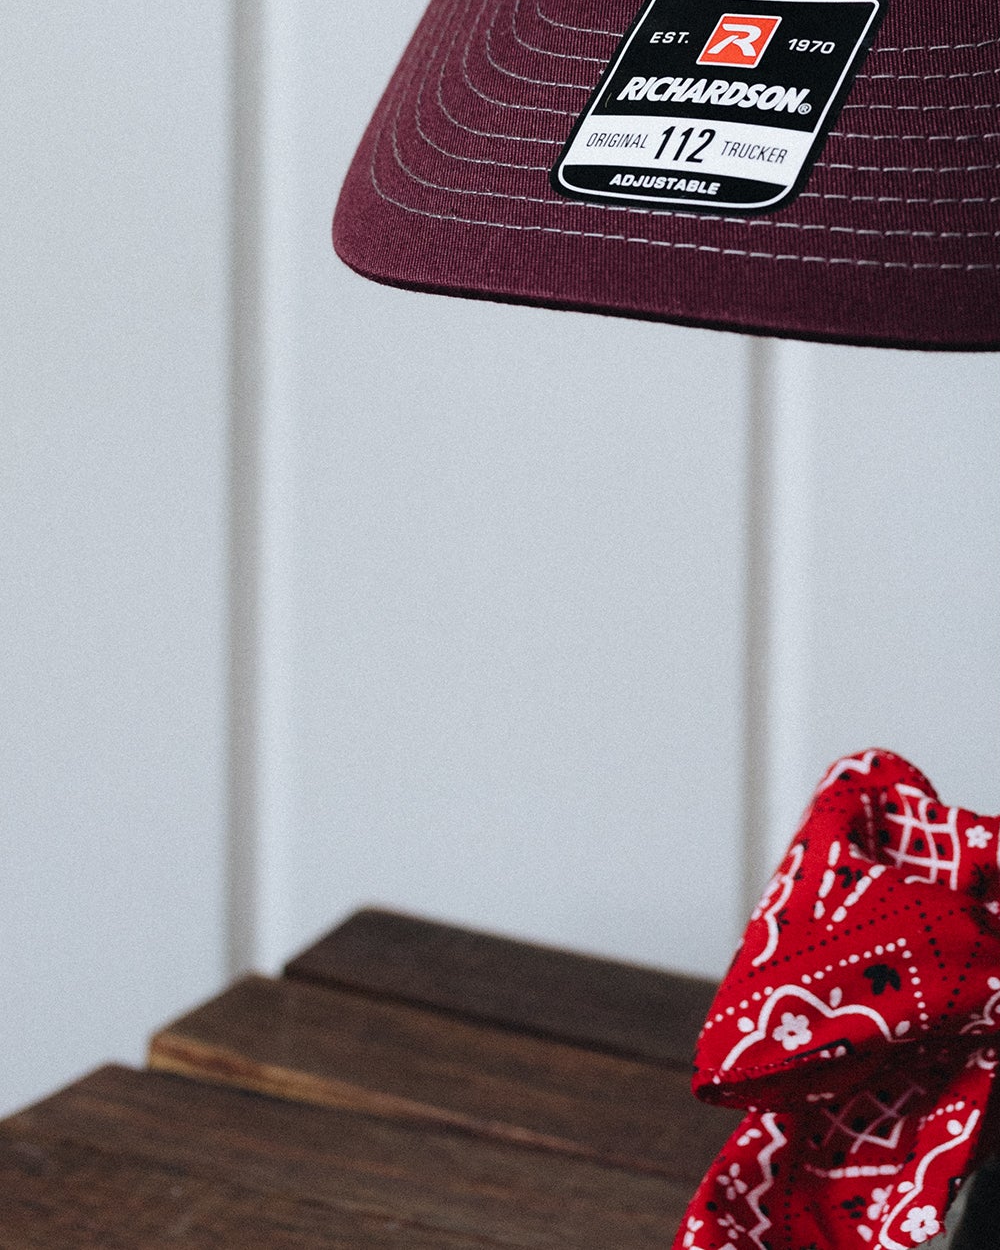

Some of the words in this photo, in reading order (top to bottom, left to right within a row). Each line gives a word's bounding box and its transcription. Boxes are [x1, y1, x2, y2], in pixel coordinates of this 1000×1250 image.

[650, 31, 690, 44] EST.
[788, 38, 835, 54] 1970
[586, 132, 649, 149] ORIGINAL
[654, 125, 716, 164] 112
[721, 140, 788, 164] TRUCKER
[609, 173, 721, 195] ADJUSTABLE
